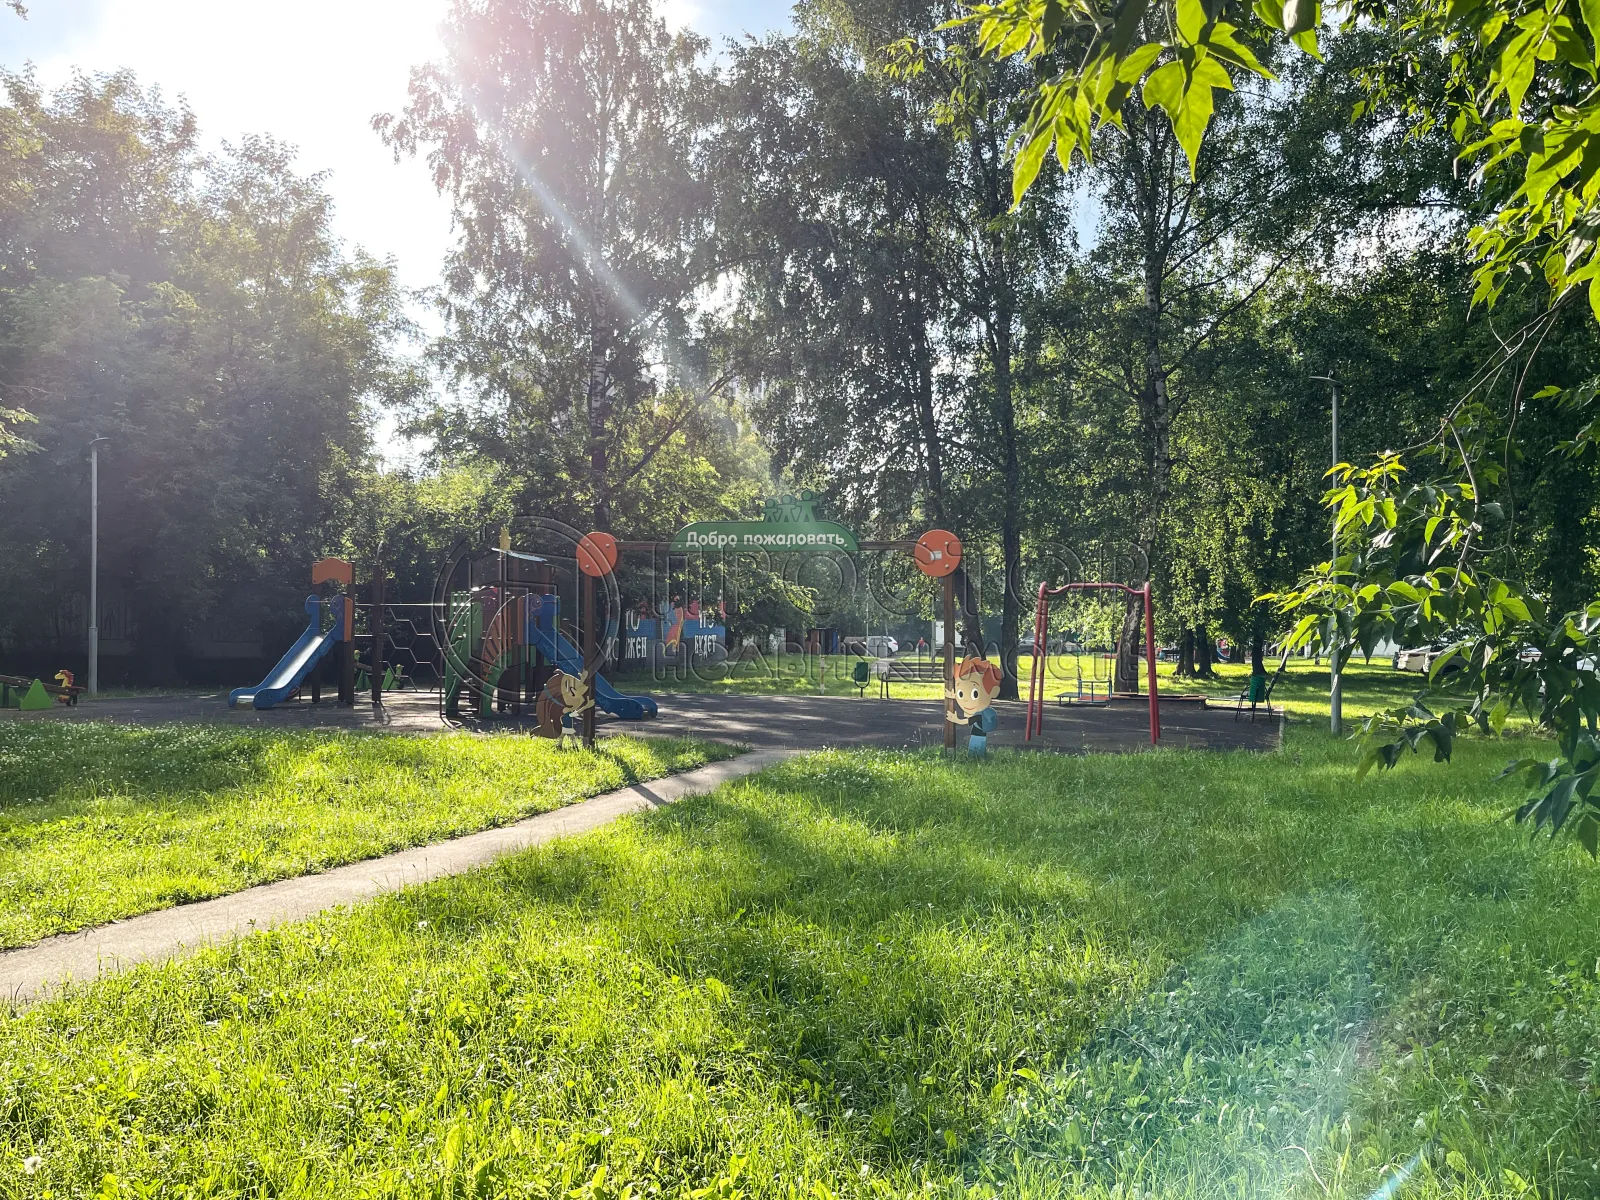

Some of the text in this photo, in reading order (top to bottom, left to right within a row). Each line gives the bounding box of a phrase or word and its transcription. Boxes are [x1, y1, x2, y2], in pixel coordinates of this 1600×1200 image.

[686, 531, 845, 549] Добро пожаловать
[605, 637, 648, 663] ДОЖЕН
[694, 635, 717, 659] БУДЕТ
